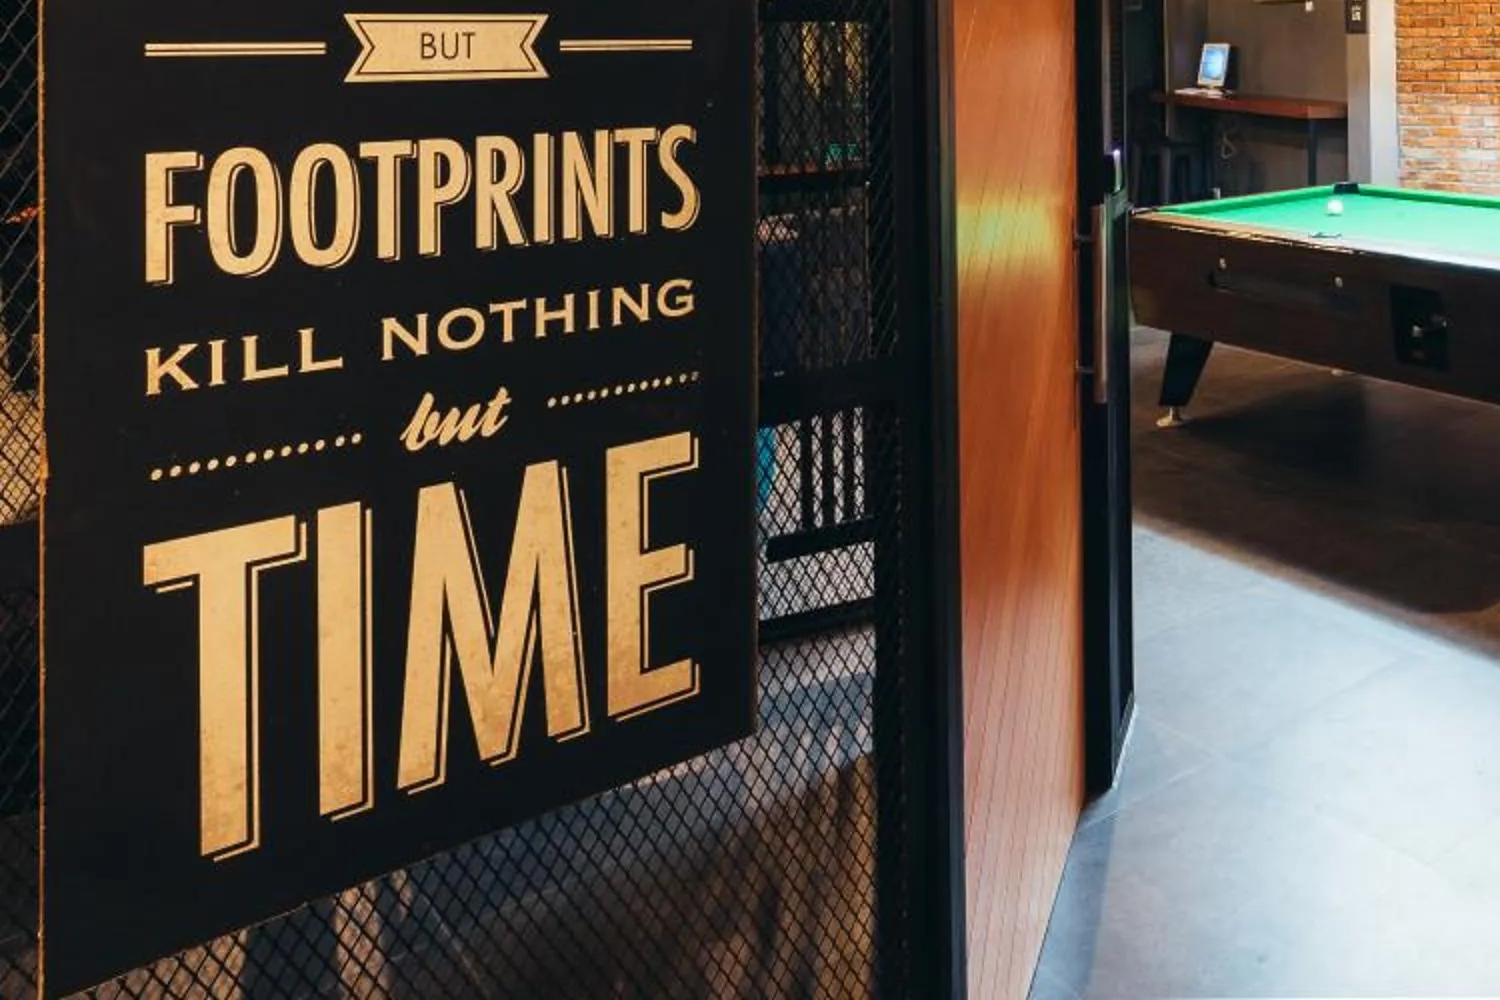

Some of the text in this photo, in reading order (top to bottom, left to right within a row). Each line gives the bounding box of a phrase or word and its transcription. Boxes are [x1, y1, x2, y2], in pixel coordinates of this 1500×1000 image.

[420, 32, 475, 60] BUT
[144, 124, 700, 285] FOOTPRINTS
[144, 279, 694, 396] KILL NOTHING
[399, 387, 512, 452] but
[143, 431, 700, 863] TIME
